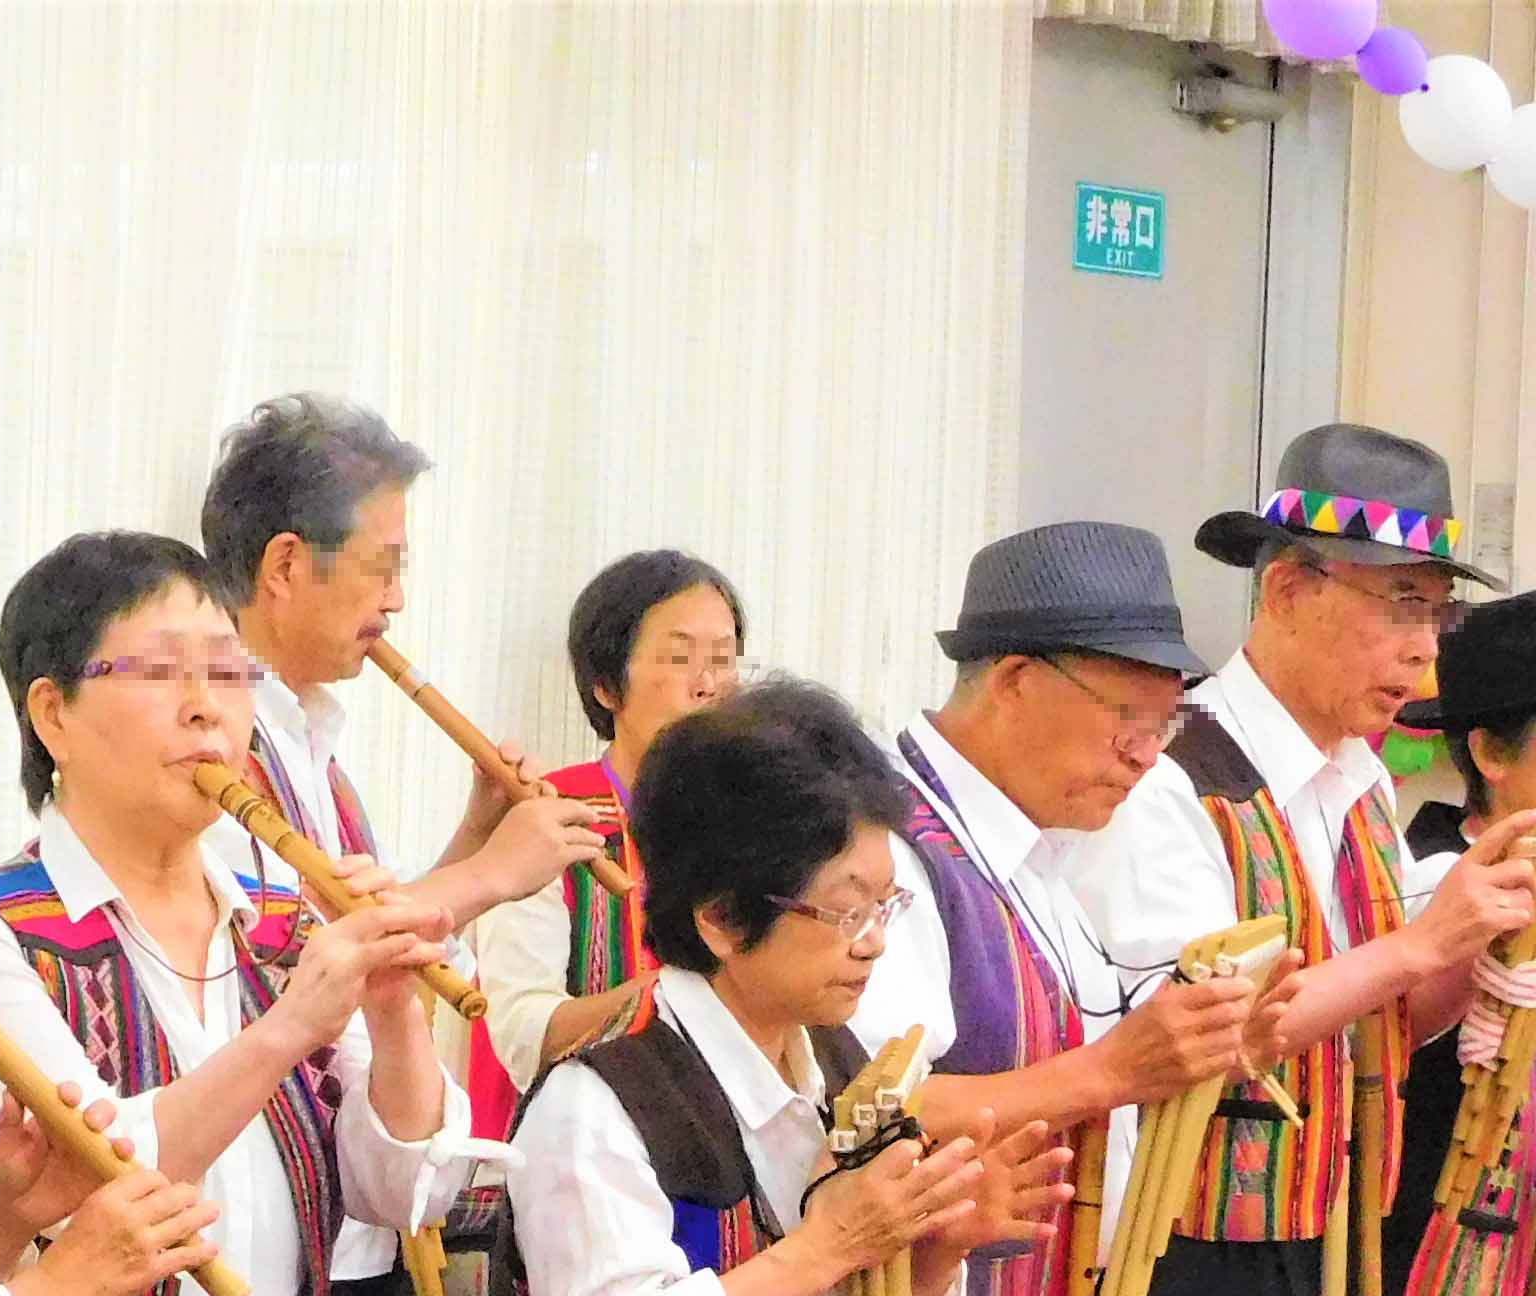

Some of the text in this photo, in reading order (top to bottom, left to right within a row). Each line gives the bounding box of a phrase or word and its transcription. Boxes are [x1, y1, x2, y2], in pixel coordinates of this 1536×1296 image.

[1086, 194, 1154, 248] 非常口
[1106, 247, 1134, 267] EXIT
